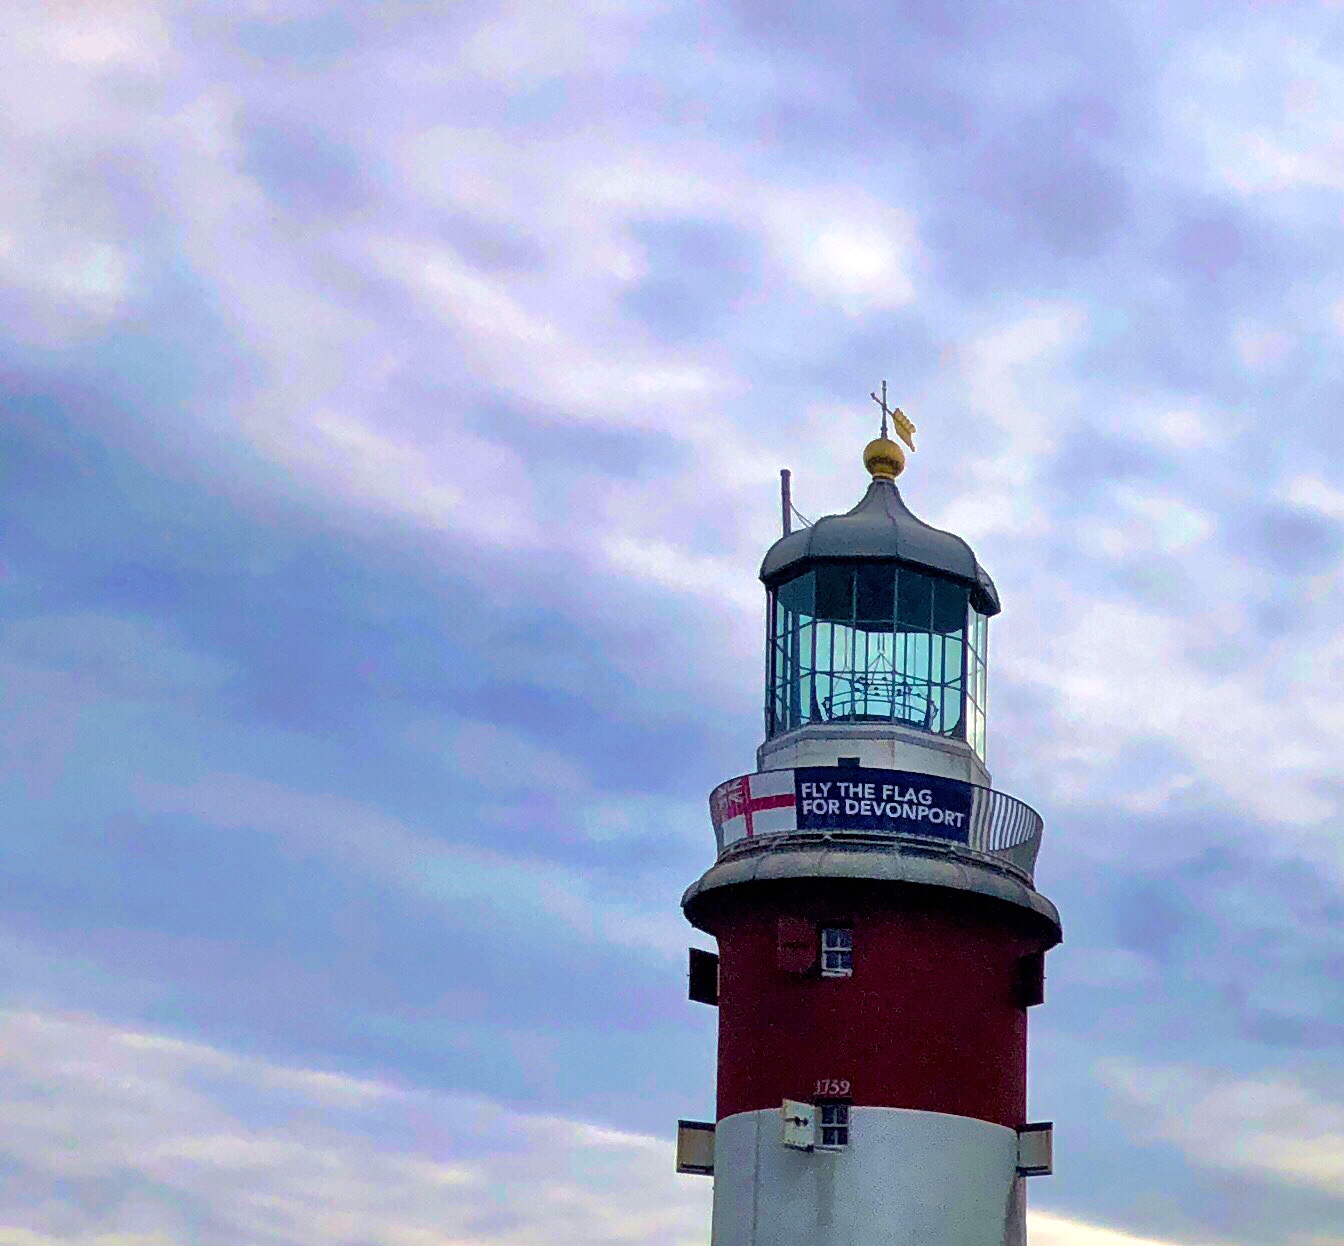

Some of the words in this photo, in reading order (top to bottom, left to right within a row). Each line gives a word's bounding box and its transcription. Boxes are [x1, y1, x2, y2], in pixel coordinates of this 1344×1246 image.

[801, 782, 832, 798] FLY
[836, 782, 876, 799] THE
[882, 784, 932, 805] FLAG
[802, 799, 840, 815] FOR
[845, 799, 965, 828] DEVONPORT
[813, 1078, 851, 1095] 1759
